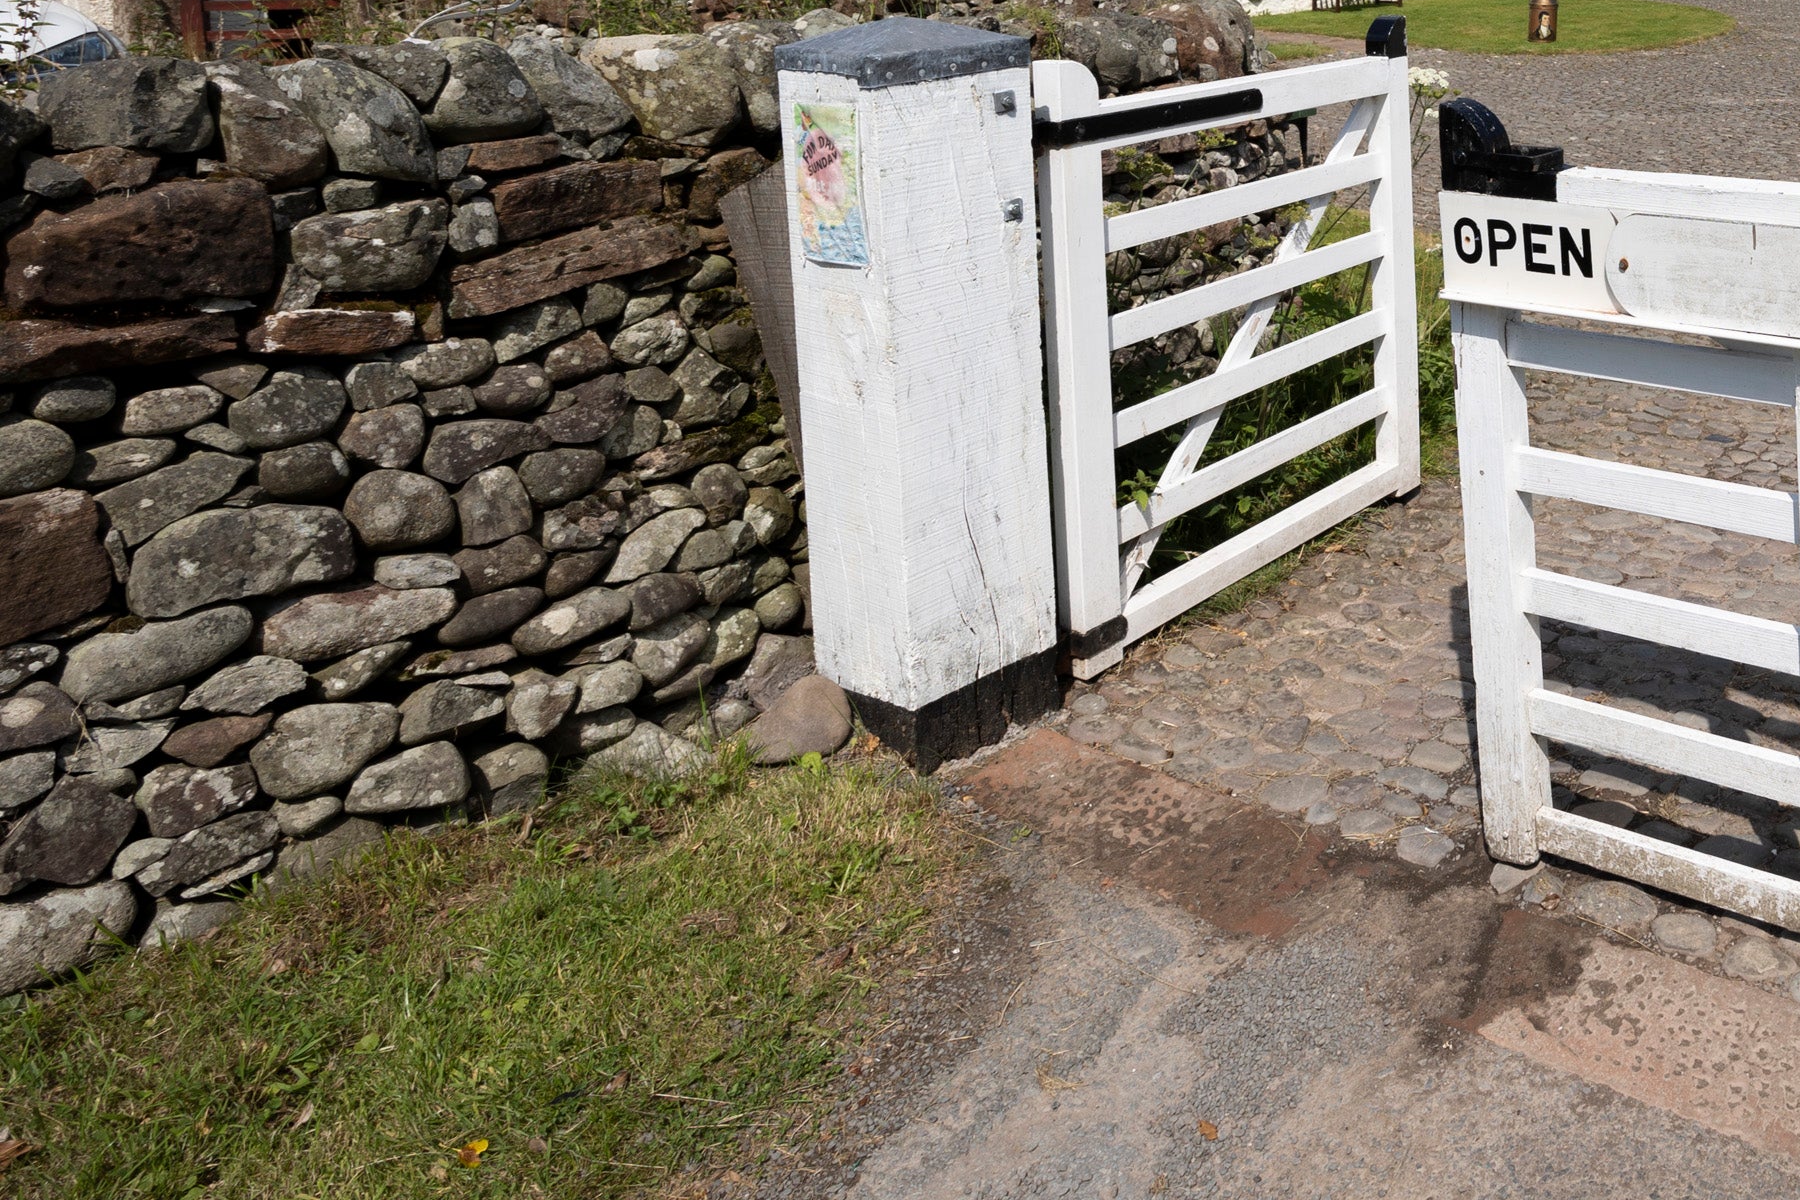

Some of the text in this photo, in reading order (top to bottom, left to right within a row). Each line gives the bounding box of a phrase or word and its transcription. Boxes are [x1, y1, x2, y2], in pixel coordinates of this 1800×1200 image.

[803, 142, 817, 165] FUN
[808, 151, 838, 176] SUNDAY
[1454, 216, 1594, 279] OPEN
